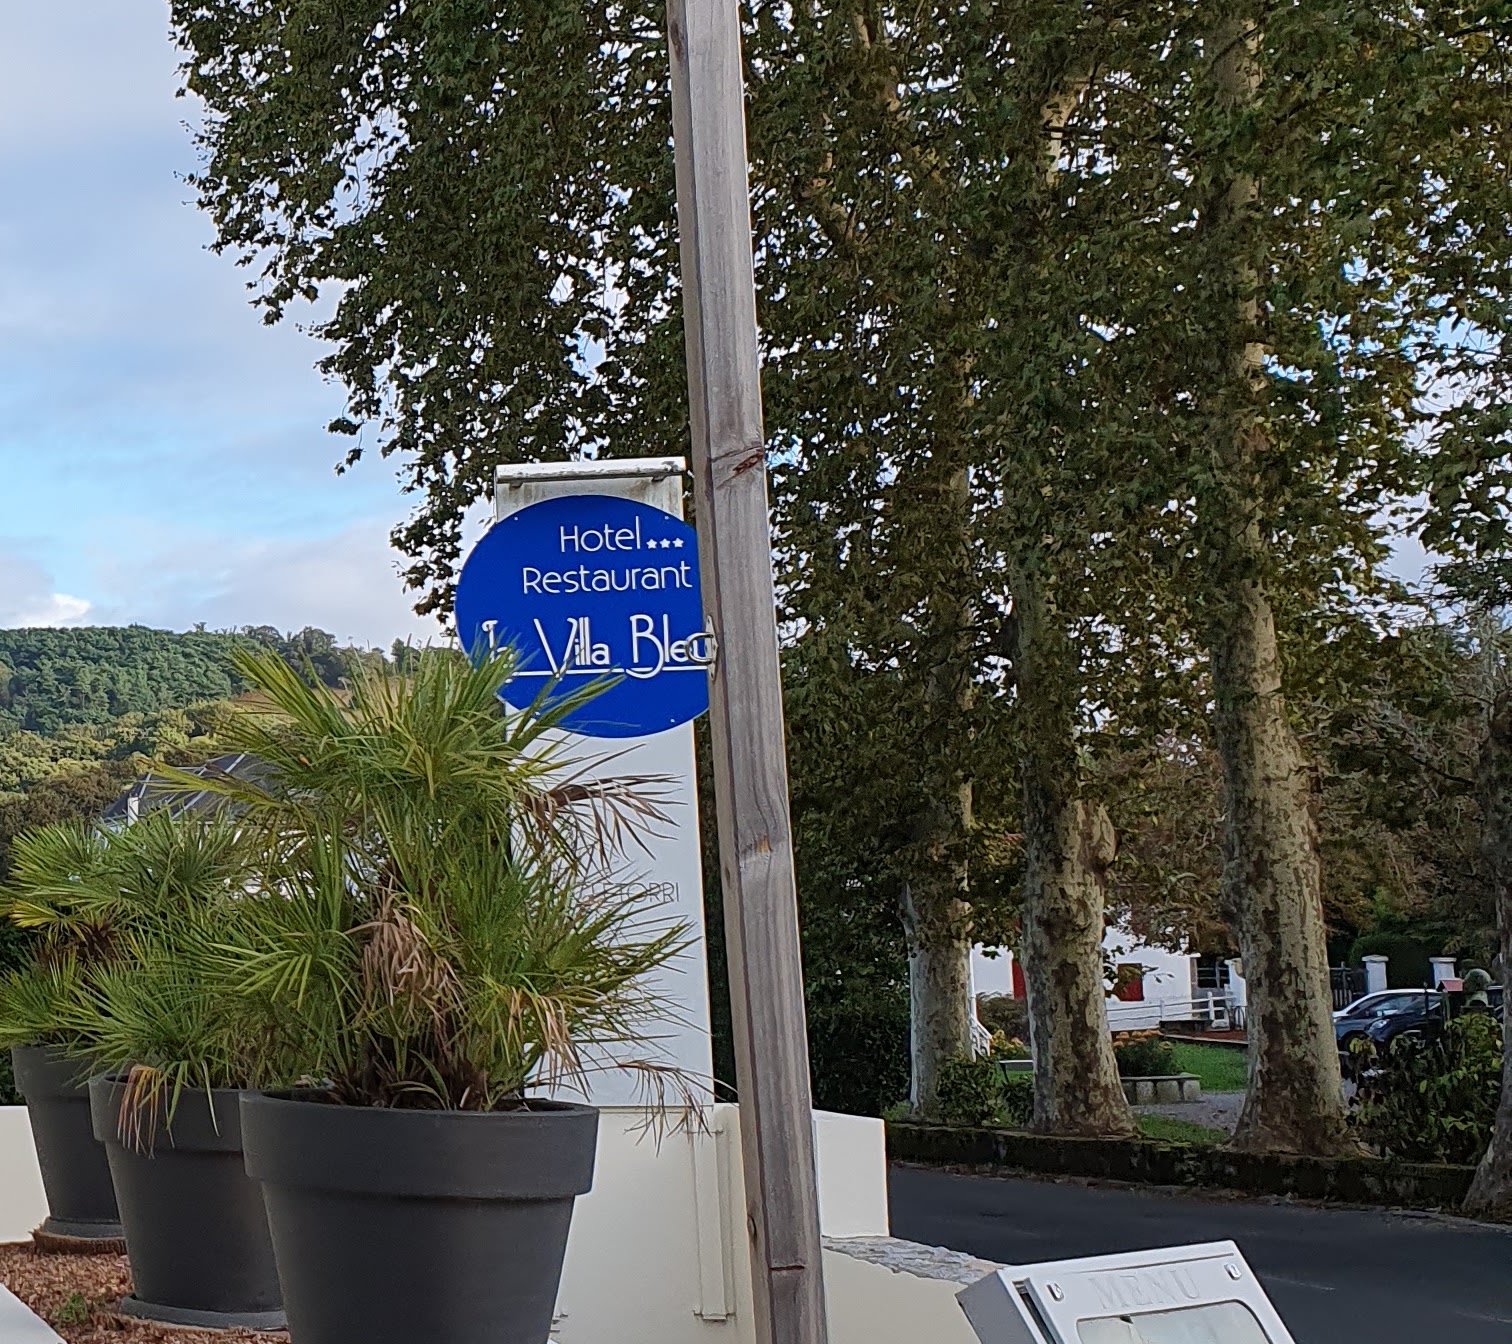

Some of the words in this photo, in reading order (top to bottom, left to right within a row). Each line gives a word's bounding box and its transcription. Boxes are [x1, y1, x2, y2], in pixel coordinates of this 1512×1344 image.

[559, 515, 642, 553] Hotel
[522, 560, 693, 595] Restaurant
[533, 616, 610, 680] Villa
[1087, 1267, 1200, 1310] MENU
